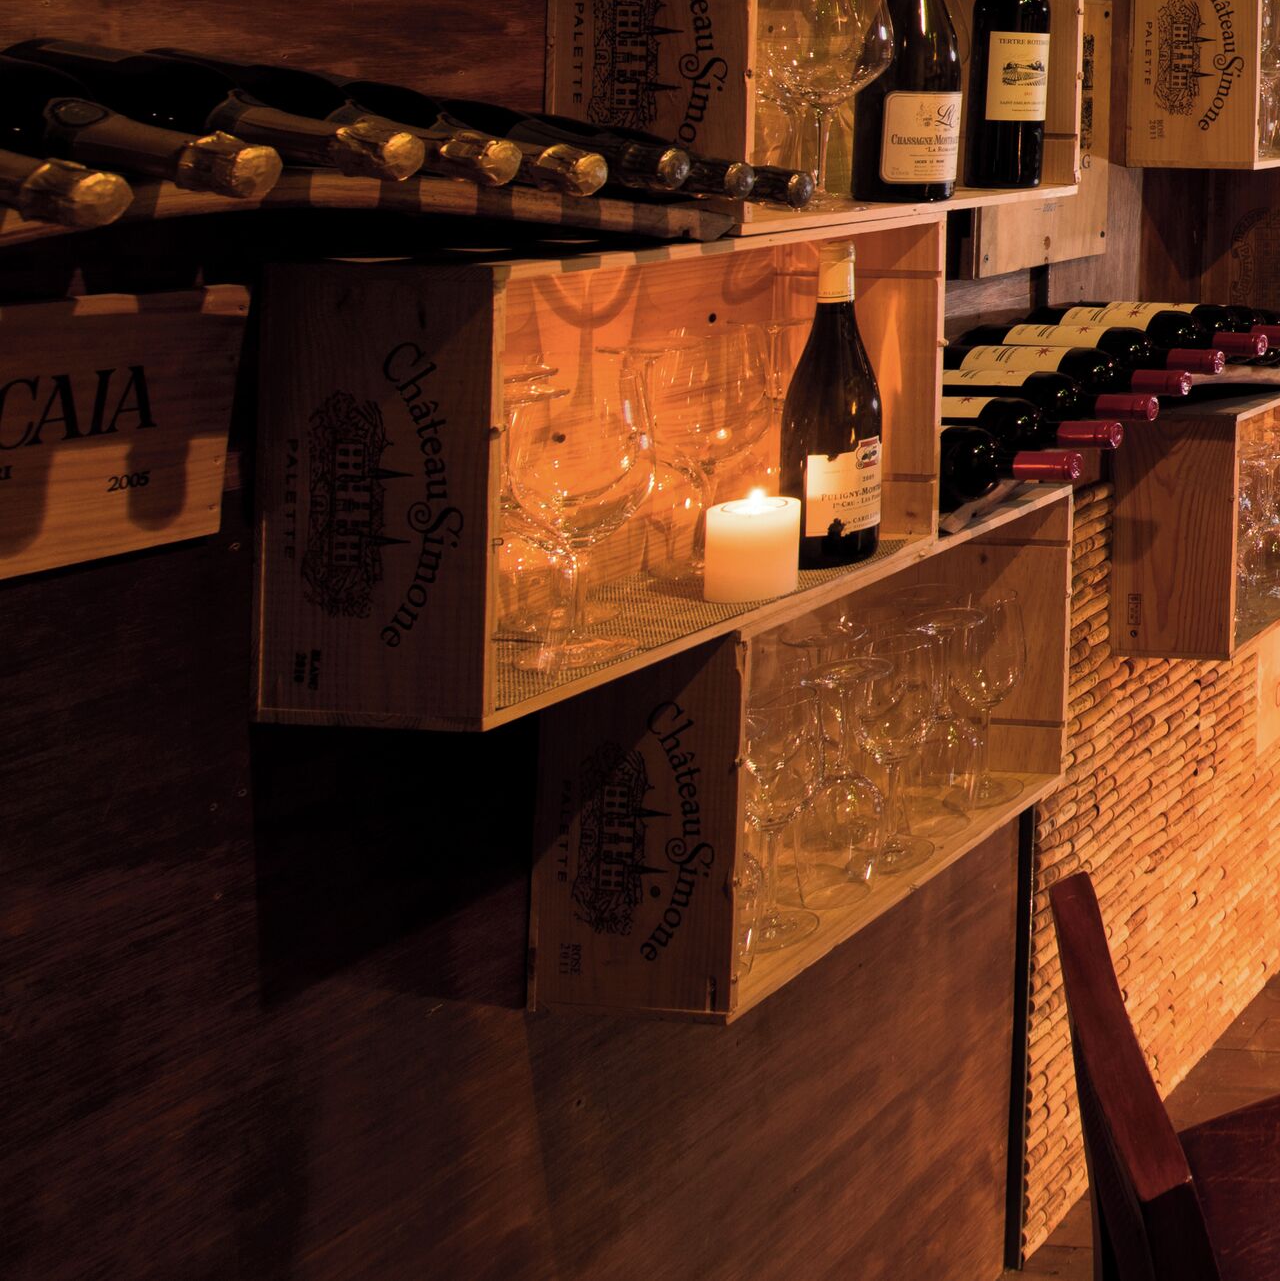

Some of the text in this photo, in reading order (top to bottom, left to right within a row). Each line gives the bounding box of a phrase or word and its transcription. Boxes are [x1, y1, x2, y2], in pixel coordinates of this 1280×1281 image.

[572, 2, 584, 105] PALETTE
[677, 52, 731, 146] Simo
[1145, 21, 1154, 87] PALETTE
[1198, 53, 1246, 132] Simone
[107, 470, 151, 493] 2005
[284, 438, 299, 561] PALETTE
[381, 341, 465, 650] Château Simone
[560, 779, 572, 884] PALETTE
[640, 701, 716, 964] Château Simone
